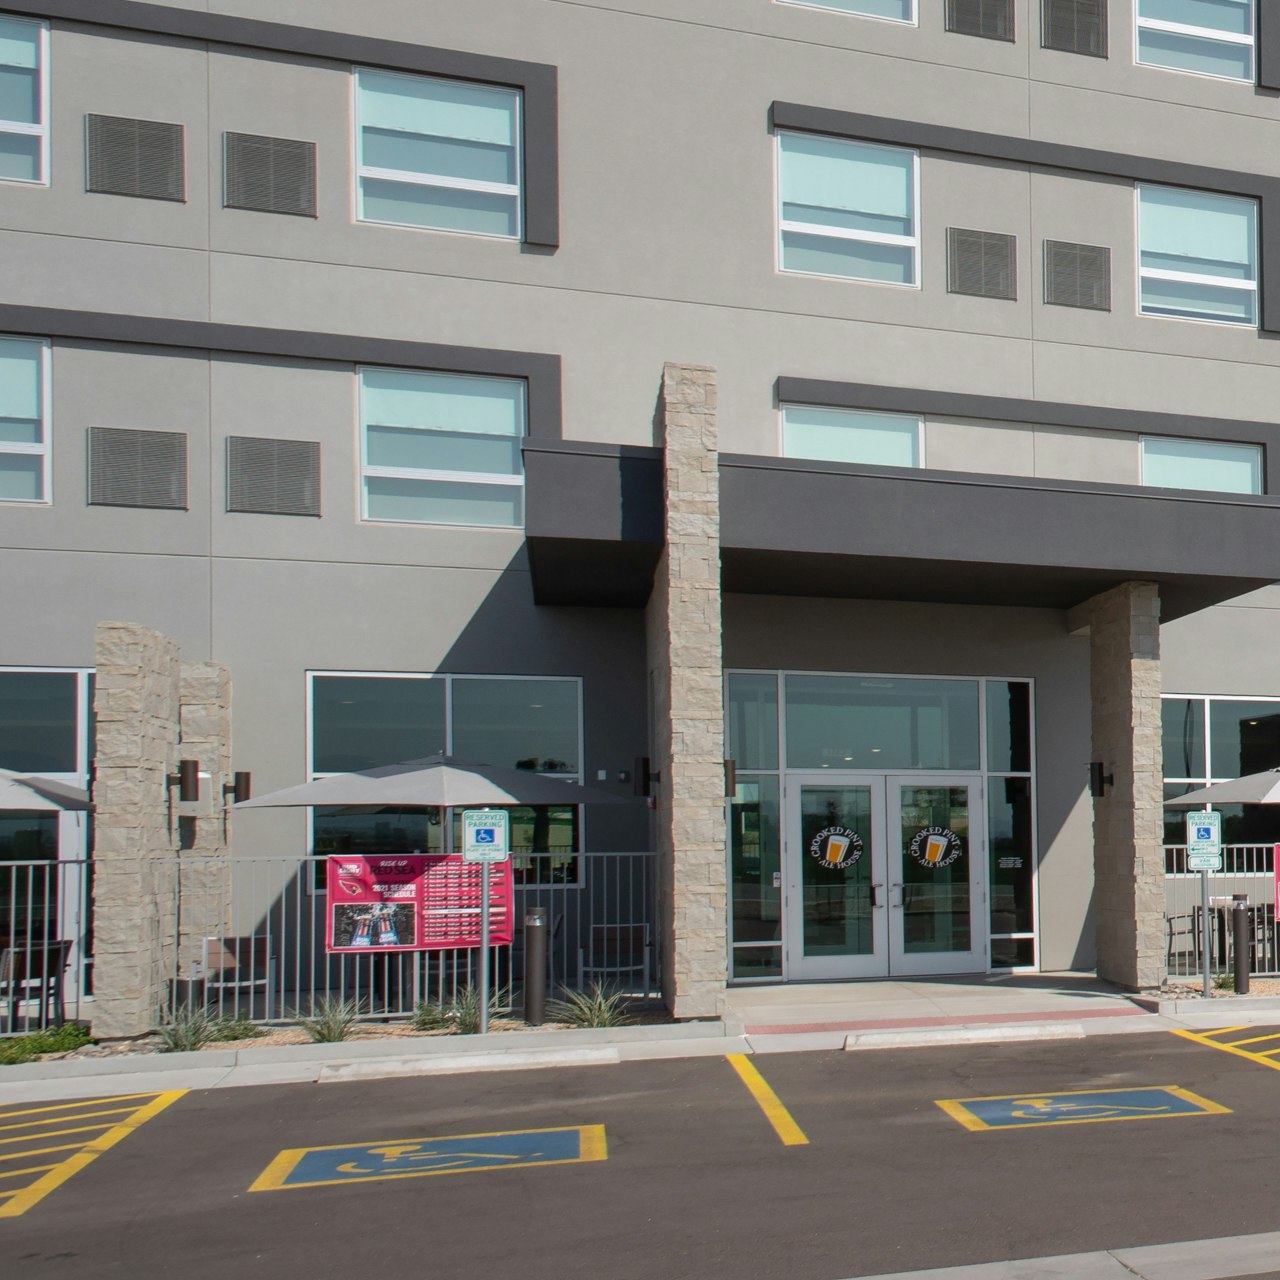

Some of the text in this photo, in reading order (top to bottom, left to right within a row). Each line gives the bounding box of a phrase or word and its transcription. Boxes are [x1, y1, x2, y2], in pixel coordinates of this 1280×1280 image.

[810, 826, 863, 857] CROOKED PINT
[910, 826, 961, 857] CROOKED PINT
[820, 850, 862, 869] ALE HOUSE
[919, 850, 960, 868] ALE HOUSE
[371, 865, 415, 875] RED SEA
